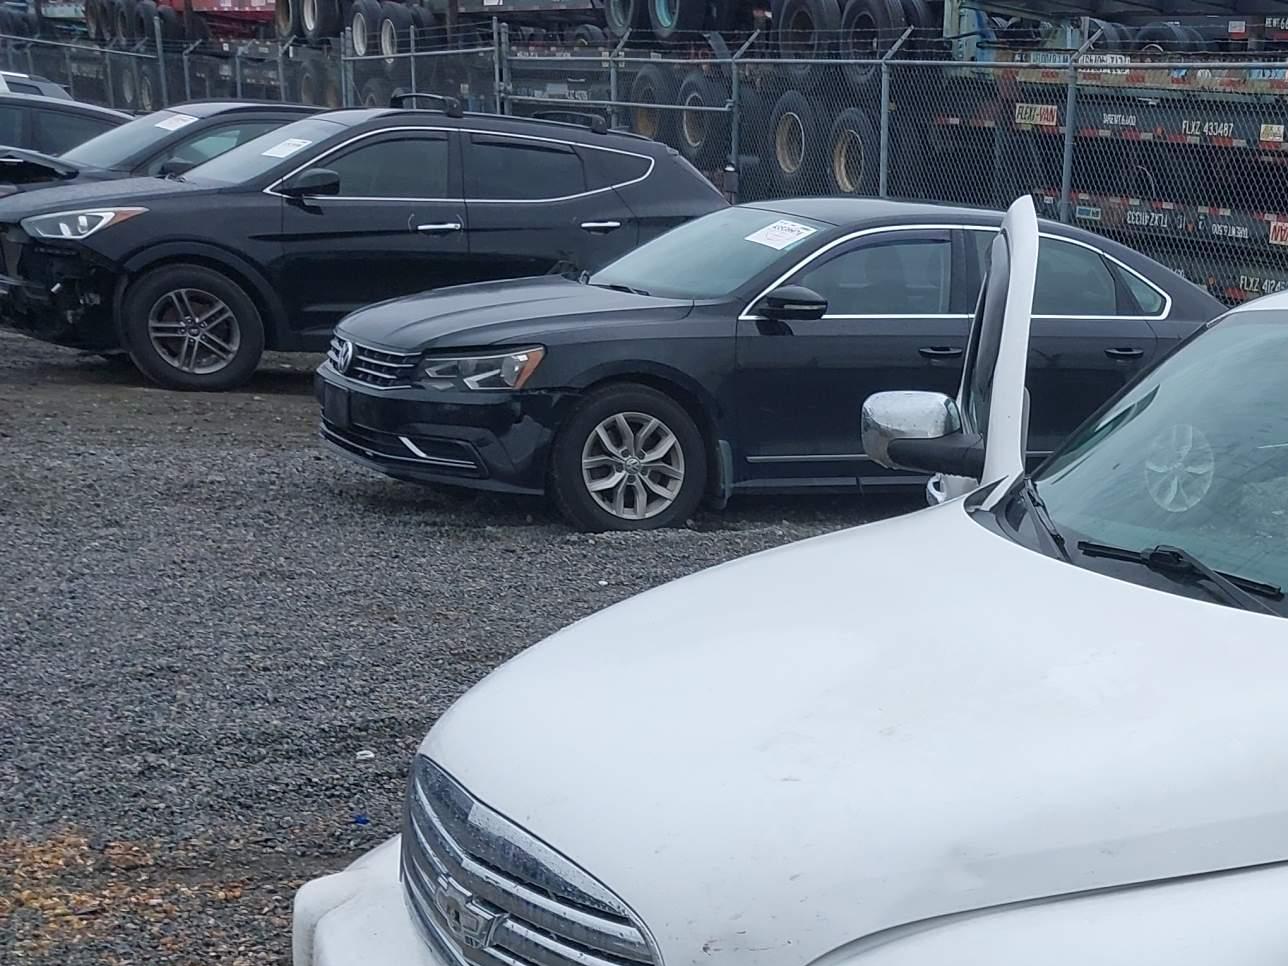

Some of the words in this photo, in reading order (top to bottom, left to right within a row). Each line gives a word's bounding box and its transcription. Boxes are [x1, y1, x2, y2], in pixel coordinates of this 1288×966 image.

[1182, 120, 1200, 135] FLXZ
[1203, 121, 1233, 136] 433487
[1240, 275, 1259, 292] FLXZ
